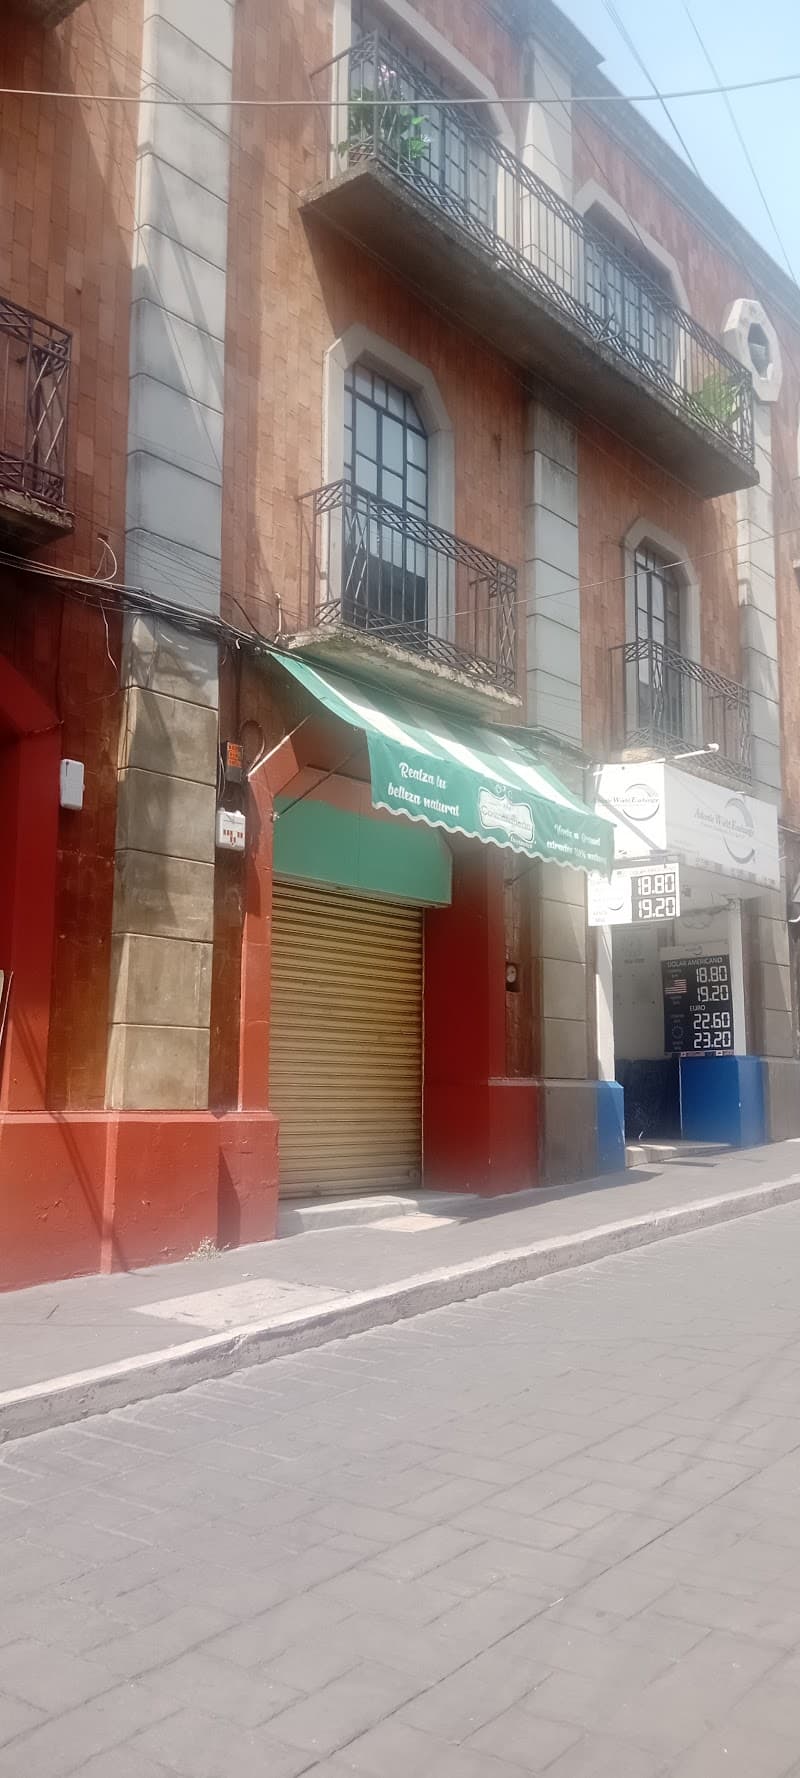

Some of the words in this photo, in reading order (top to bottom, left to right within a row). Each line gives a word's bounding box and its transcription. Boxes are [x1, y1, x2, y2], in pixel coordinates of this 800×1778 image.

[399, 762, 435, 785] Realza
[388, 782, 420, 805] belleza
[424, 798, 459, 816] natural
[637, 873, 675, 896] 18.80
[638, 897, 676, 918] 19.20
[696, 965, 728, 983] 18.80
[697, 985, 729, 1002] 19.20
[690, 1004, 706, 1012] EURO
[693, 1012, 730, 1029] 22.60
[693, 1031, 731, 1049] 23.20
